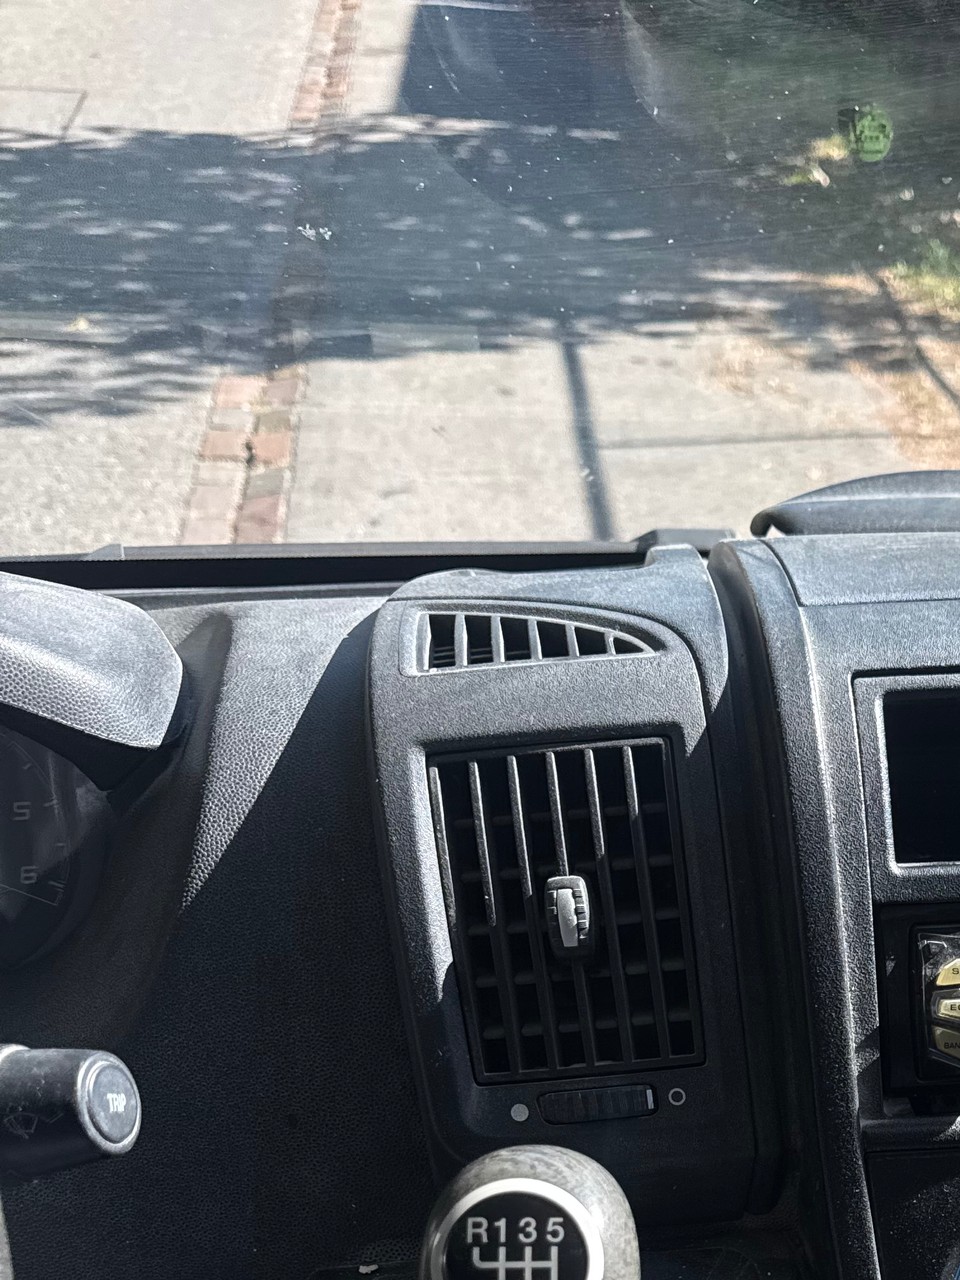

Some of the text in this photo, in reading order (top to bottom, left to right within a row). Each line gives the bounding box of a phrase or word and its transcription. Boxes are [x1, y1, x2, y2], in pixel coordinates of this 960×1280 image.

[13, 801, 31, 821] 5
[20, 866, 38, 885] 6
[107, 1093, 126, 1112] TRIP
[467, 1217, 488, 1243] R
[519, 1217, 538, 1243] 3
[546, 1217, 565, 1243] 5
